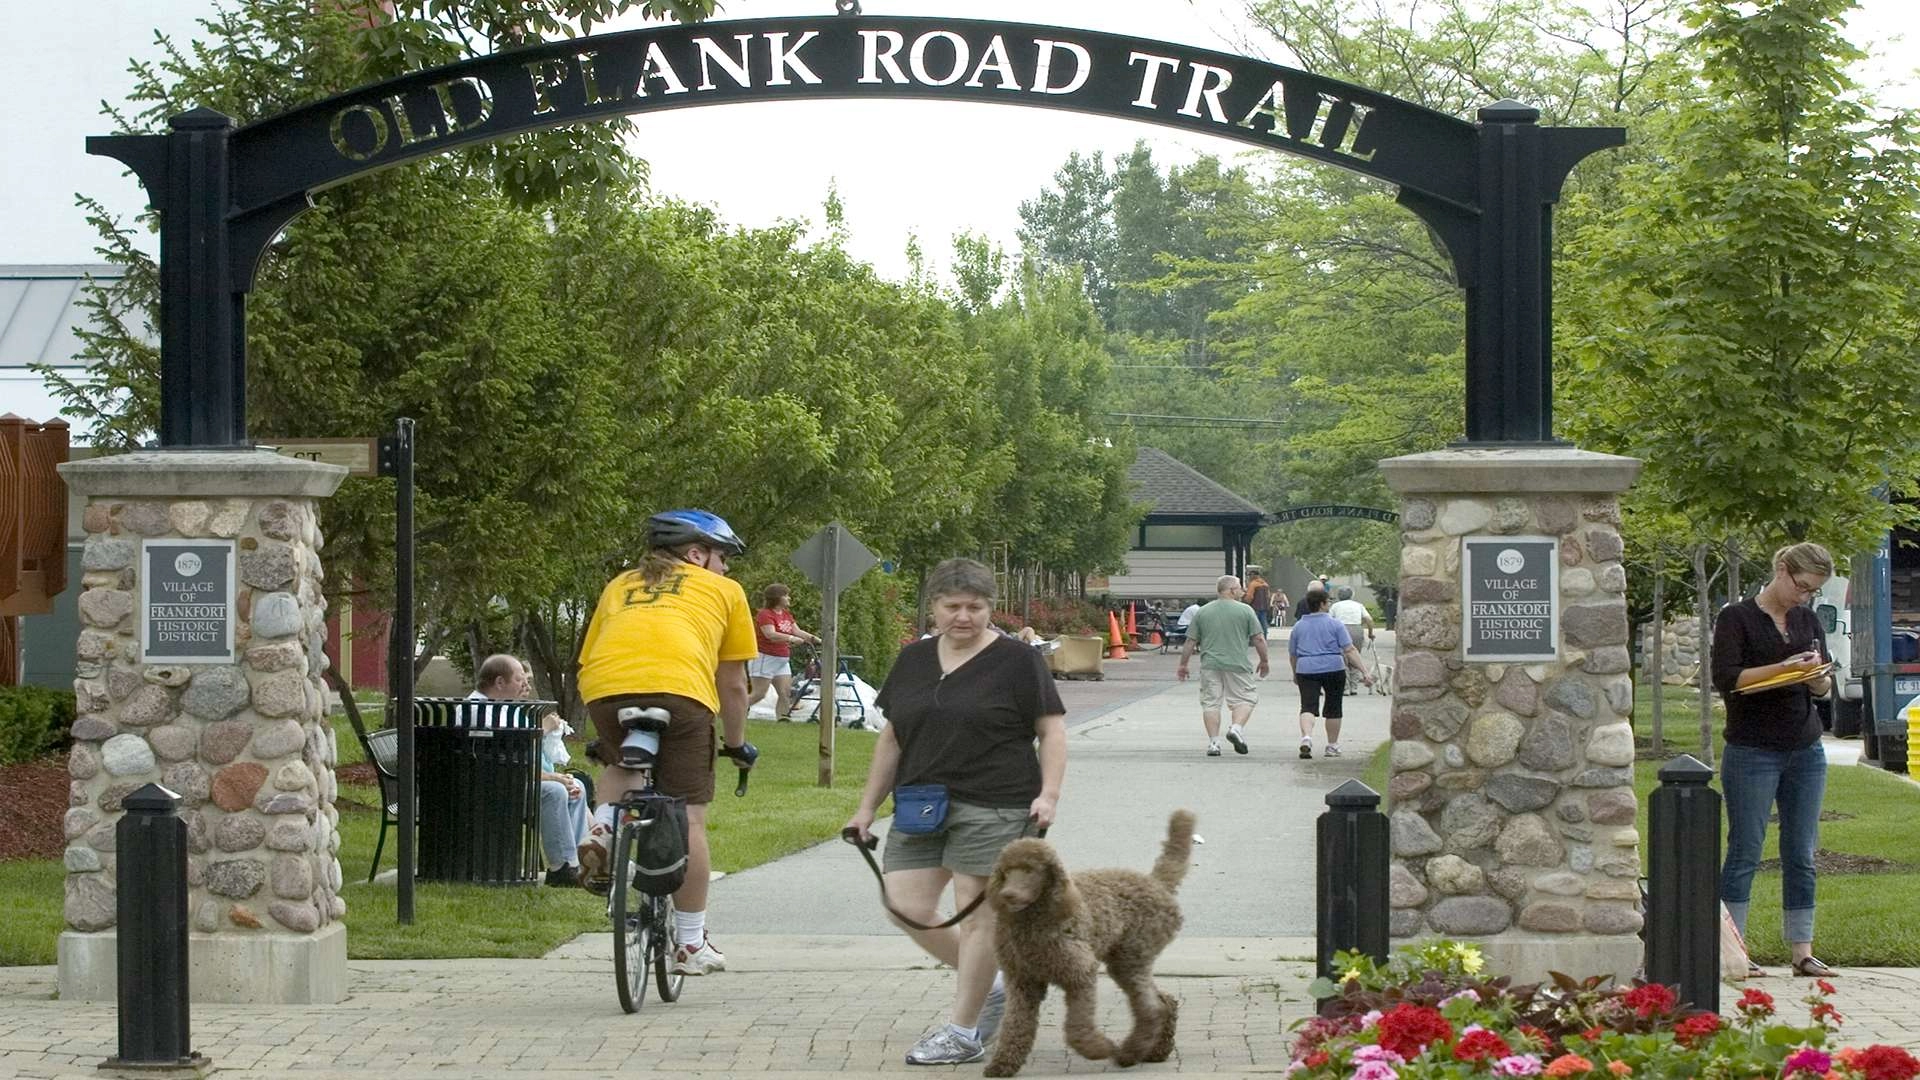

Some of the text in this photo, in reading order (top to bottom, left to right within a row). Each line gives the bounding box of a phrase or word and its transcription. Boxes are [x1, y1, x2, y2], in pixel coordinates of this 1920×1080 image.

[329, 30, 1377, 163] OLD PLANK ROAD TRAIL
[177, 560, 200, 570] 1879
[1499, 557, 1522, 567] 1879
[162, 582, 214, 592] VILLAGE
[1484, 579, 1538, 589] VILLAGE
[179, 592, 197, 602] OF
[1502, 590, 1519, 600] OF
[151, 606, 226, 618] FRANKFORT
[1472, 604, 1550, 615] FRANKFORT
[157, 621, 219, 631] HISTORIC
[1479, 619, 1543, 629] HISTORIC
[159, 632, 218, 641] DISTRICT
[1481, 630, 1542, 639] DISTRICT
